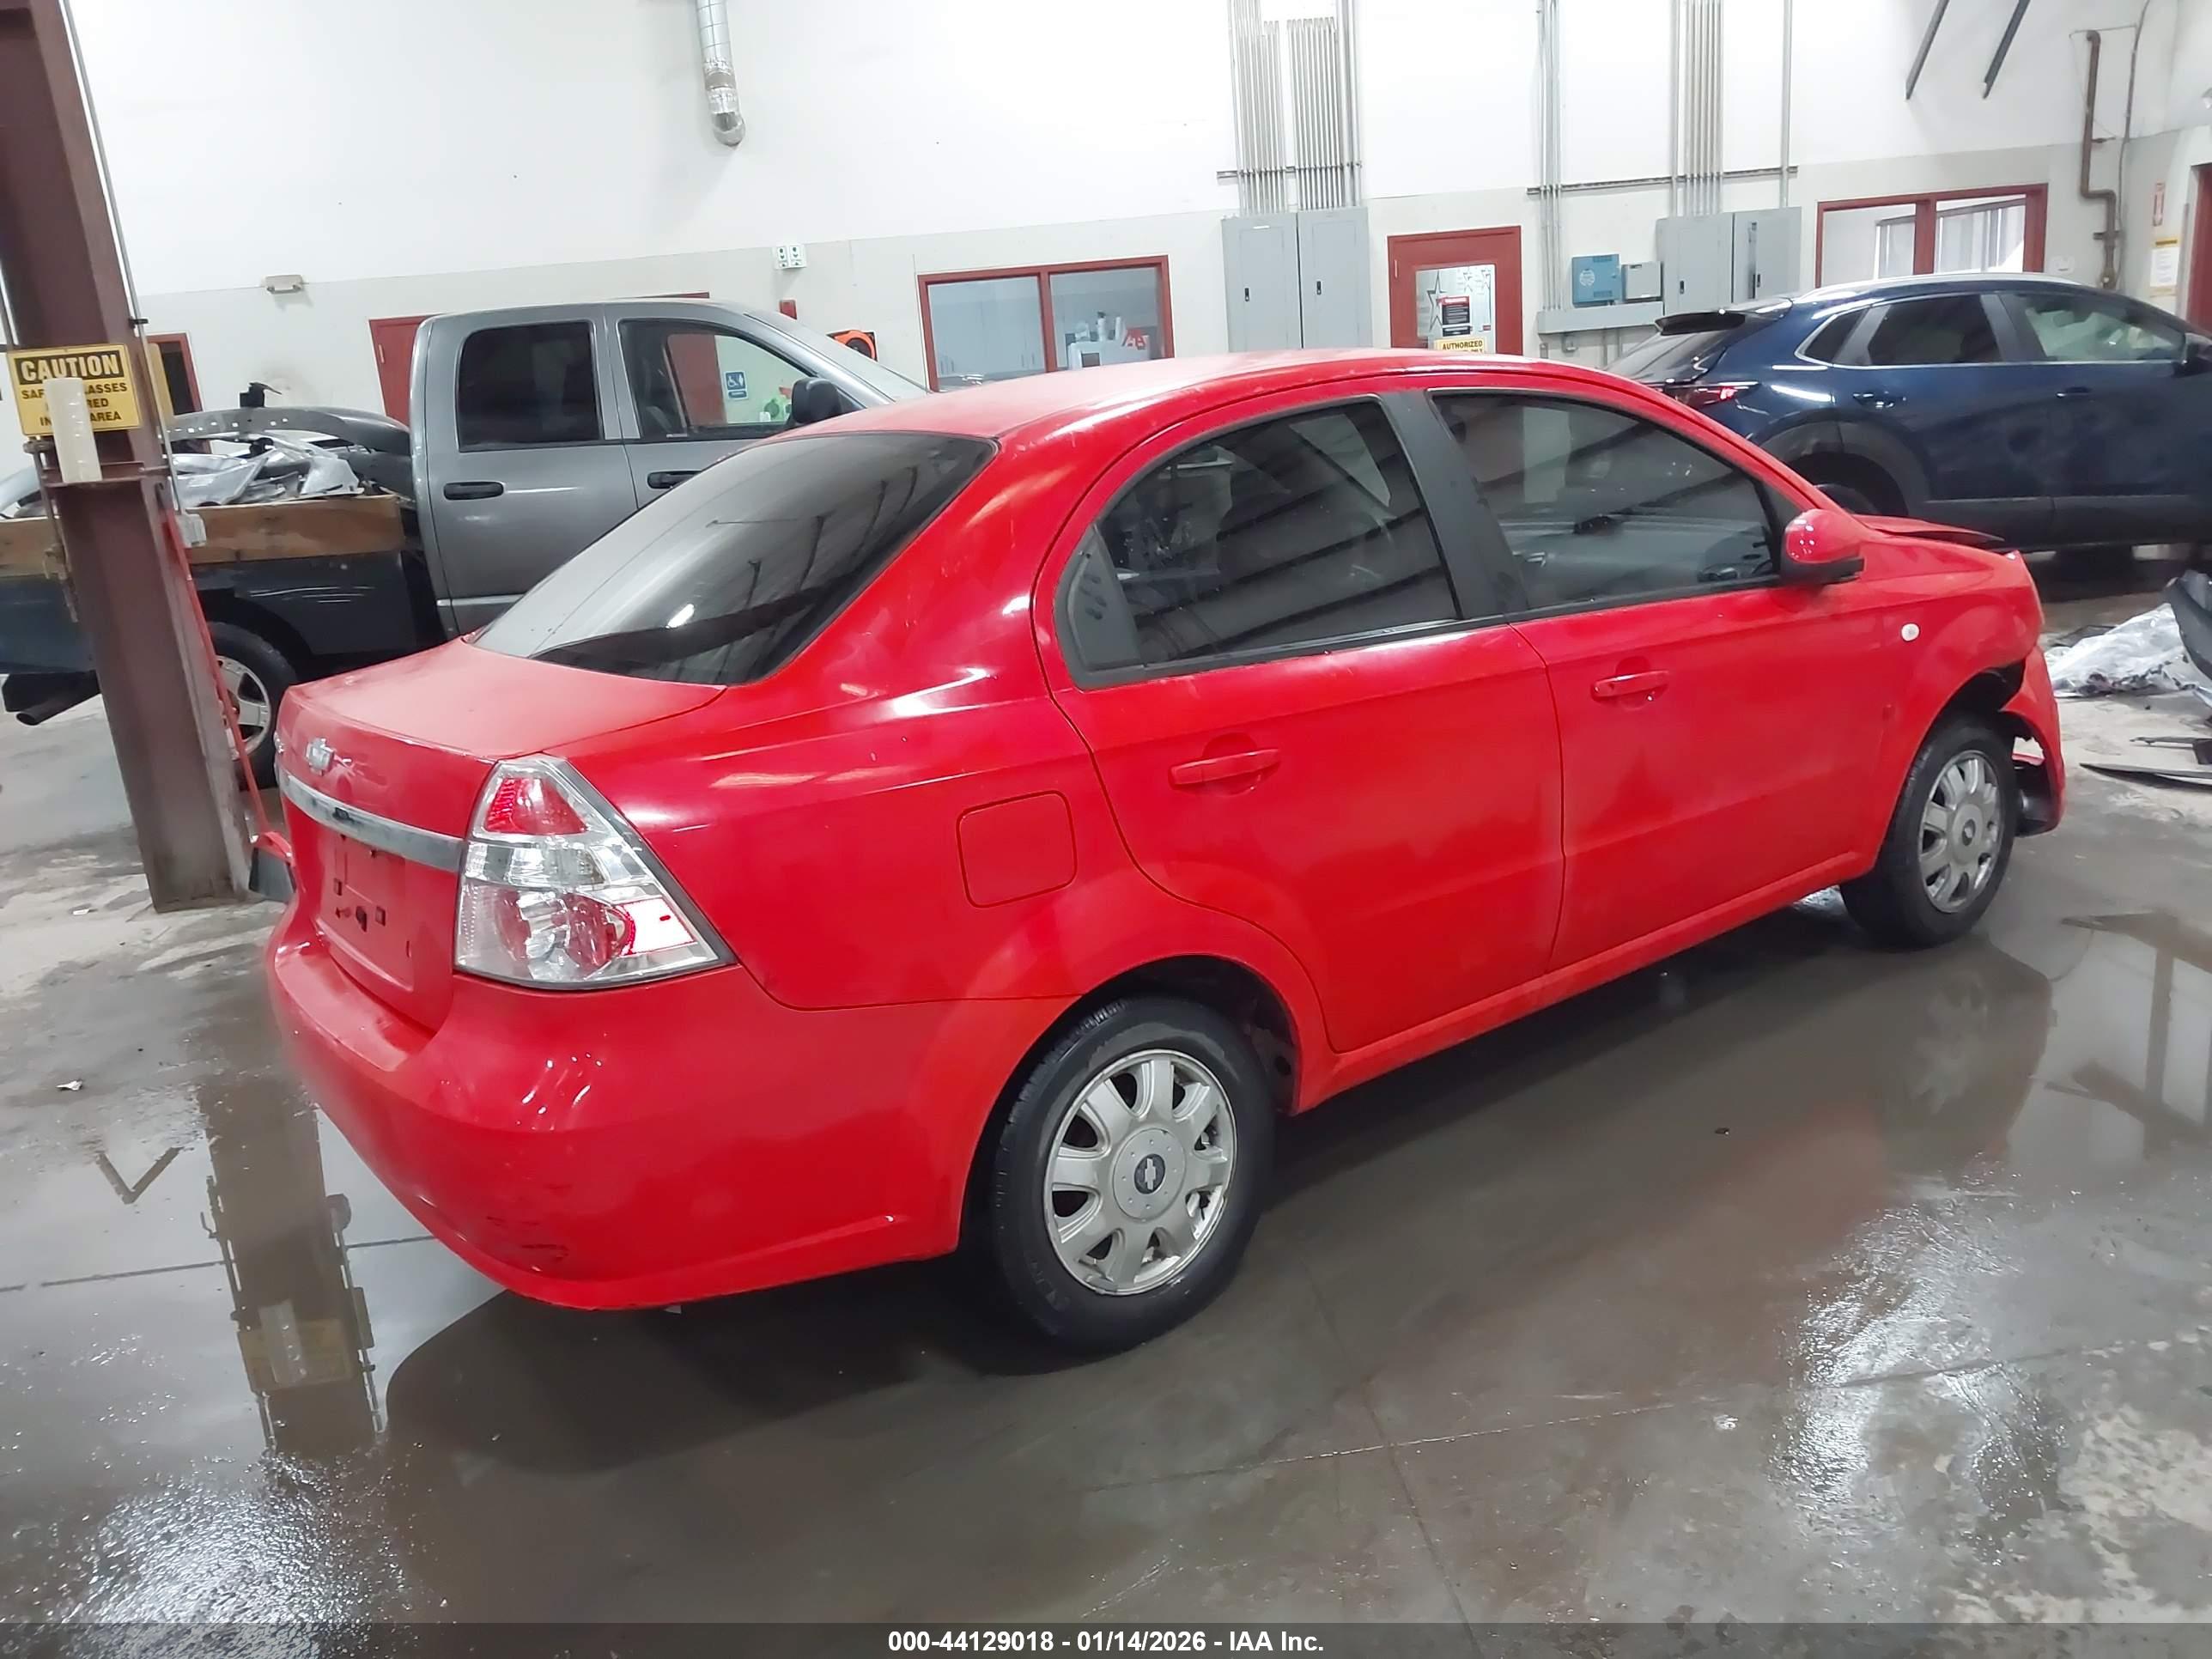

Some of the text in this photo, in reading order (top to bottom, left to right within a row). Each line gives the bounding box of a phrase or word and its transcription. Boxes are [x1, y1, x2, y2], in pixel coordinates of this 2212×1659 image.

[1443, 340, 1483, 350] AUTHORIZED
[20, 354, 119, 381] CAUTION
[84, 382, 127, 395] ASSES
